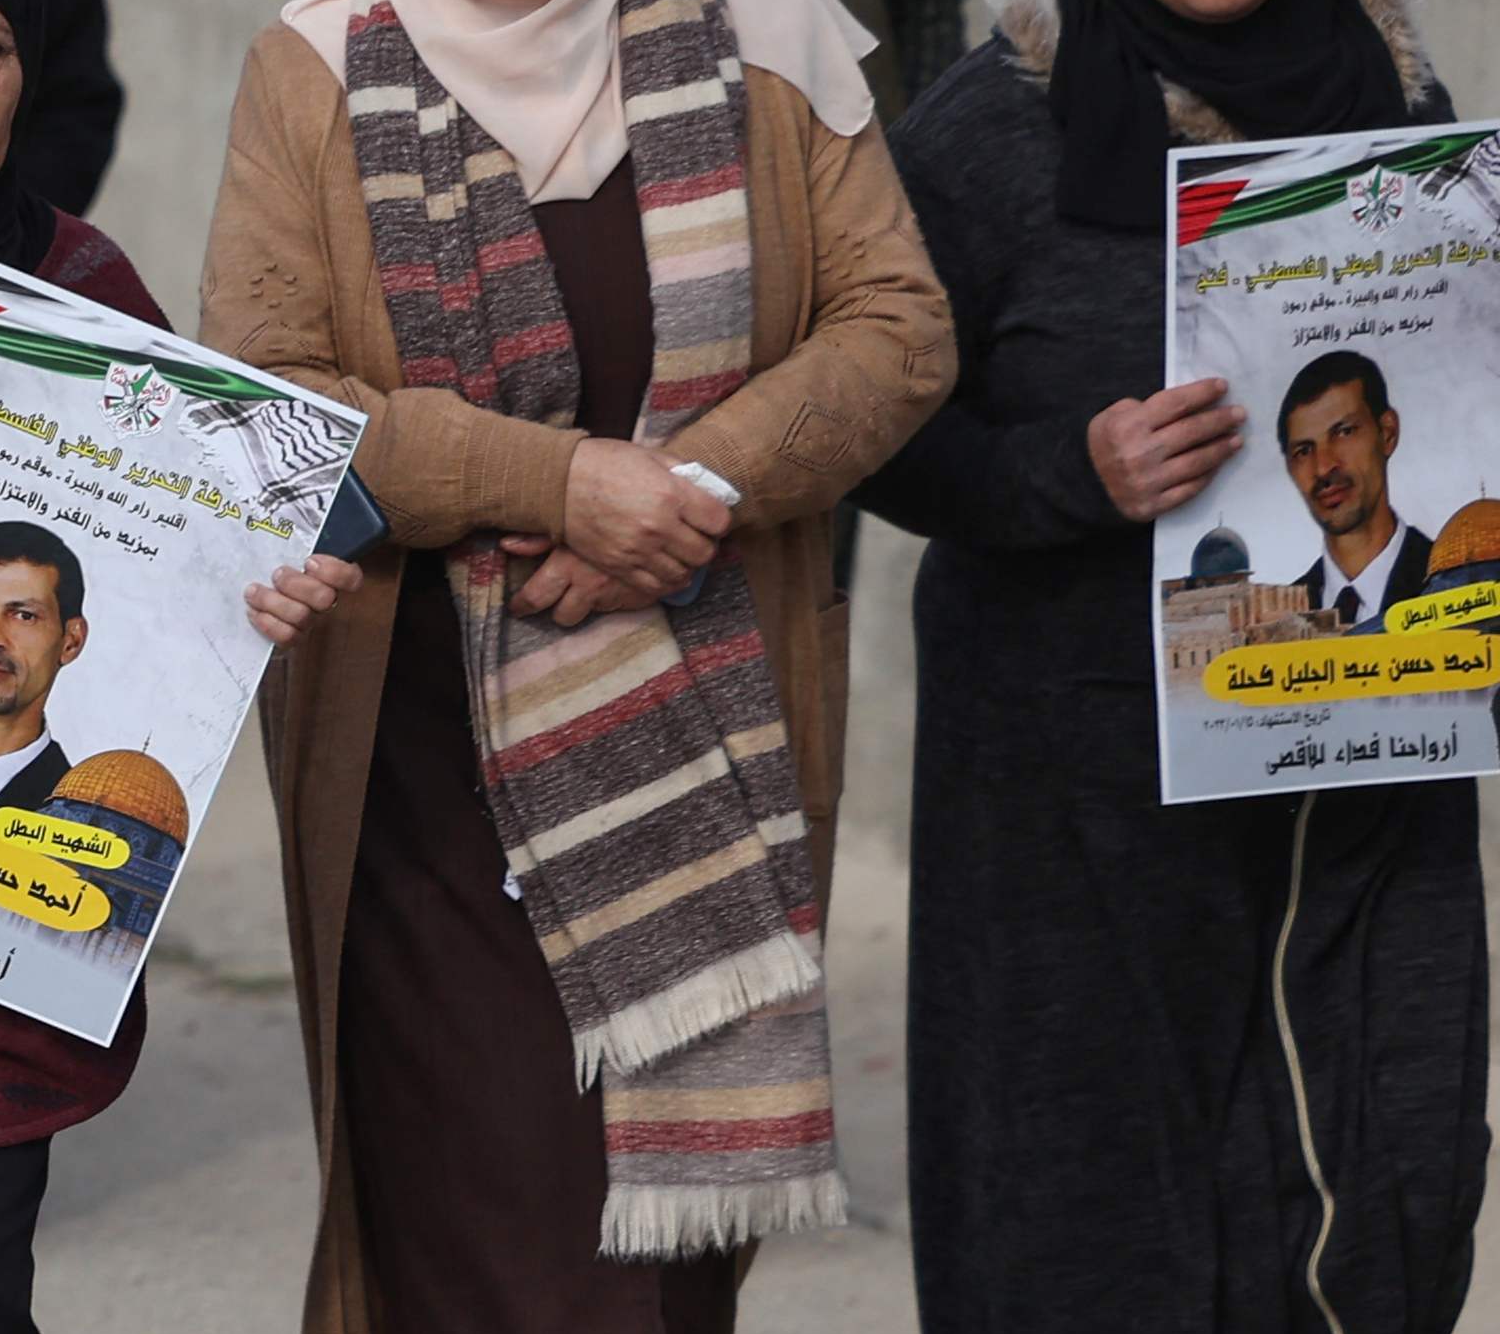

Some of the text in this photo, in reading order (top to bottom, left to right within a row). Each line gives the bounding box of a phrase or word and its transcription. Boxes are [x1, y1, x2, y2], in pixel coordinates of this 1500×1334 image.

[20, 455, 53, 478] موقع
[56, 435, 123, 472] الوطني
[63, 469, 104, 500] والبيرة
[122, 461, 193, 500] التحرير
[105, 490, 128, 507] الله
[127, 500, 150, 519] رام
[191, 485, 242, 520] حركة
[51, 506, 92, 530] الفخر
[91, 521, 111, 539] من
[151, 513, 187, 531] اقليم
[244, 513, 294, 540] تنعى
[115, 530, 158, 561] بمزيد
[1400, 587, 1497, 631] الشهيد البطل
[1226, 636, 1494, 693] أحمد حسن عبد الجليل كحلة
[1265, 722, 1457, 776] أرواحنا فداء للأقصى
[3, 818, 112, 858] الشهيد البطل
[26, 879, 87, 917] أحمد
